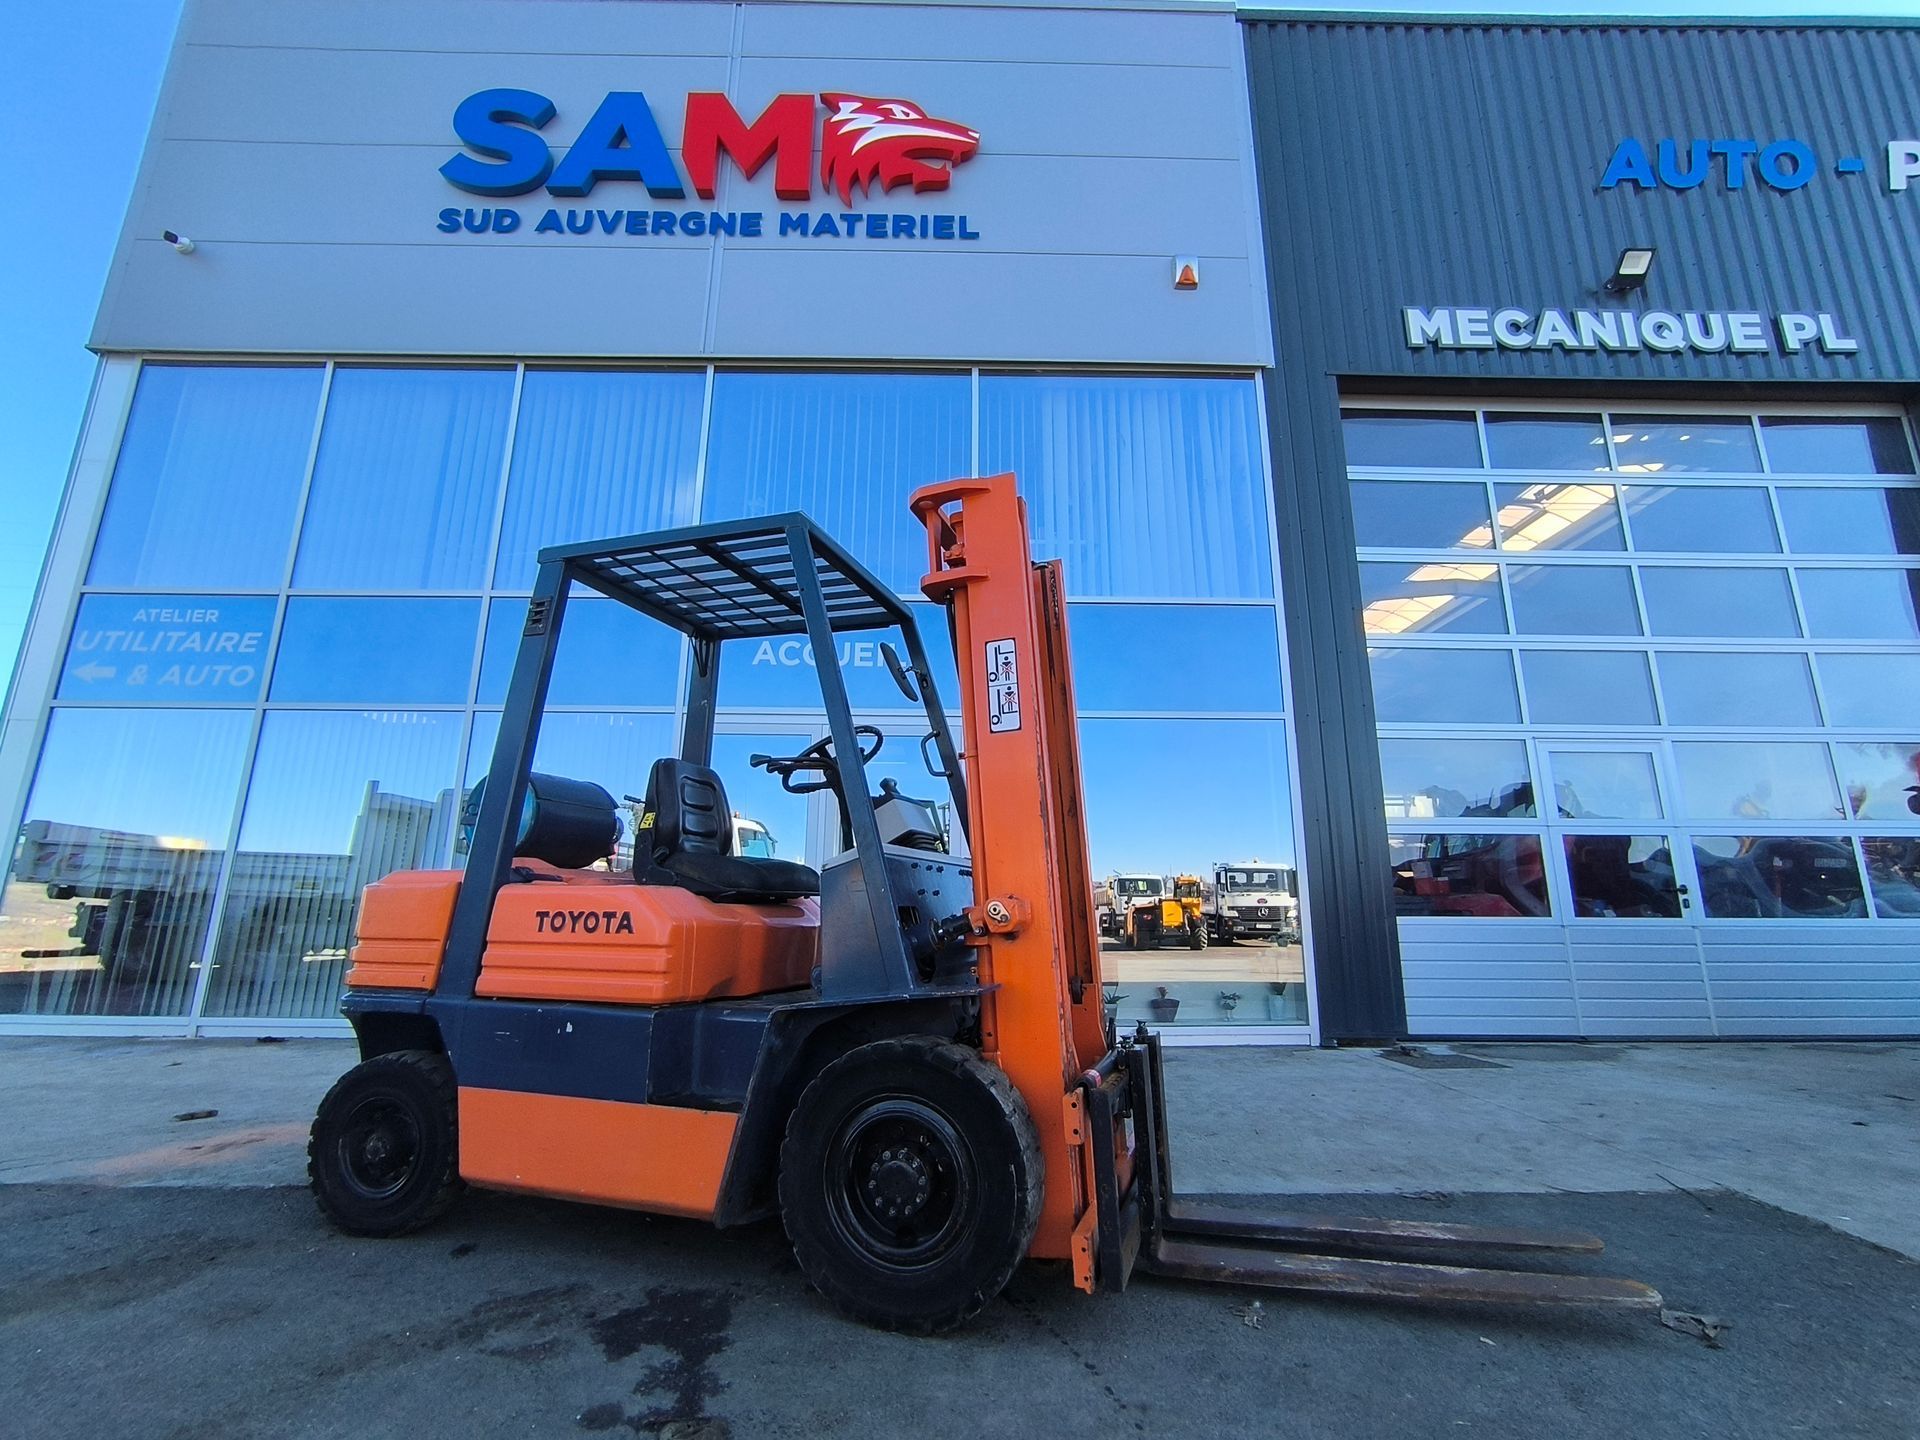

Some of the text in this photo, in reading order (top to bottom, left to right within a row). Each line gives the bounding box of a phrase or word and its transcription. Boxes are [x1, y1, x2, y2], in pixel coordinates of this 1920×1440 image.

[438, 87, 815, 200] SAM
[1600, 138, 1817, 190] AUTO
[437, 208, 980, 240] SUD AUVERGNE MATERIEL
[1403, 306, 1859, 353] MECANIQUE PL
[133, 608, 219, 623] ATELIER
[75, 630, 263, 653] UTILITAIRE
[126, 664, 256, 686] & AUTO
[535, 910, 634, 934] TOYOTA
